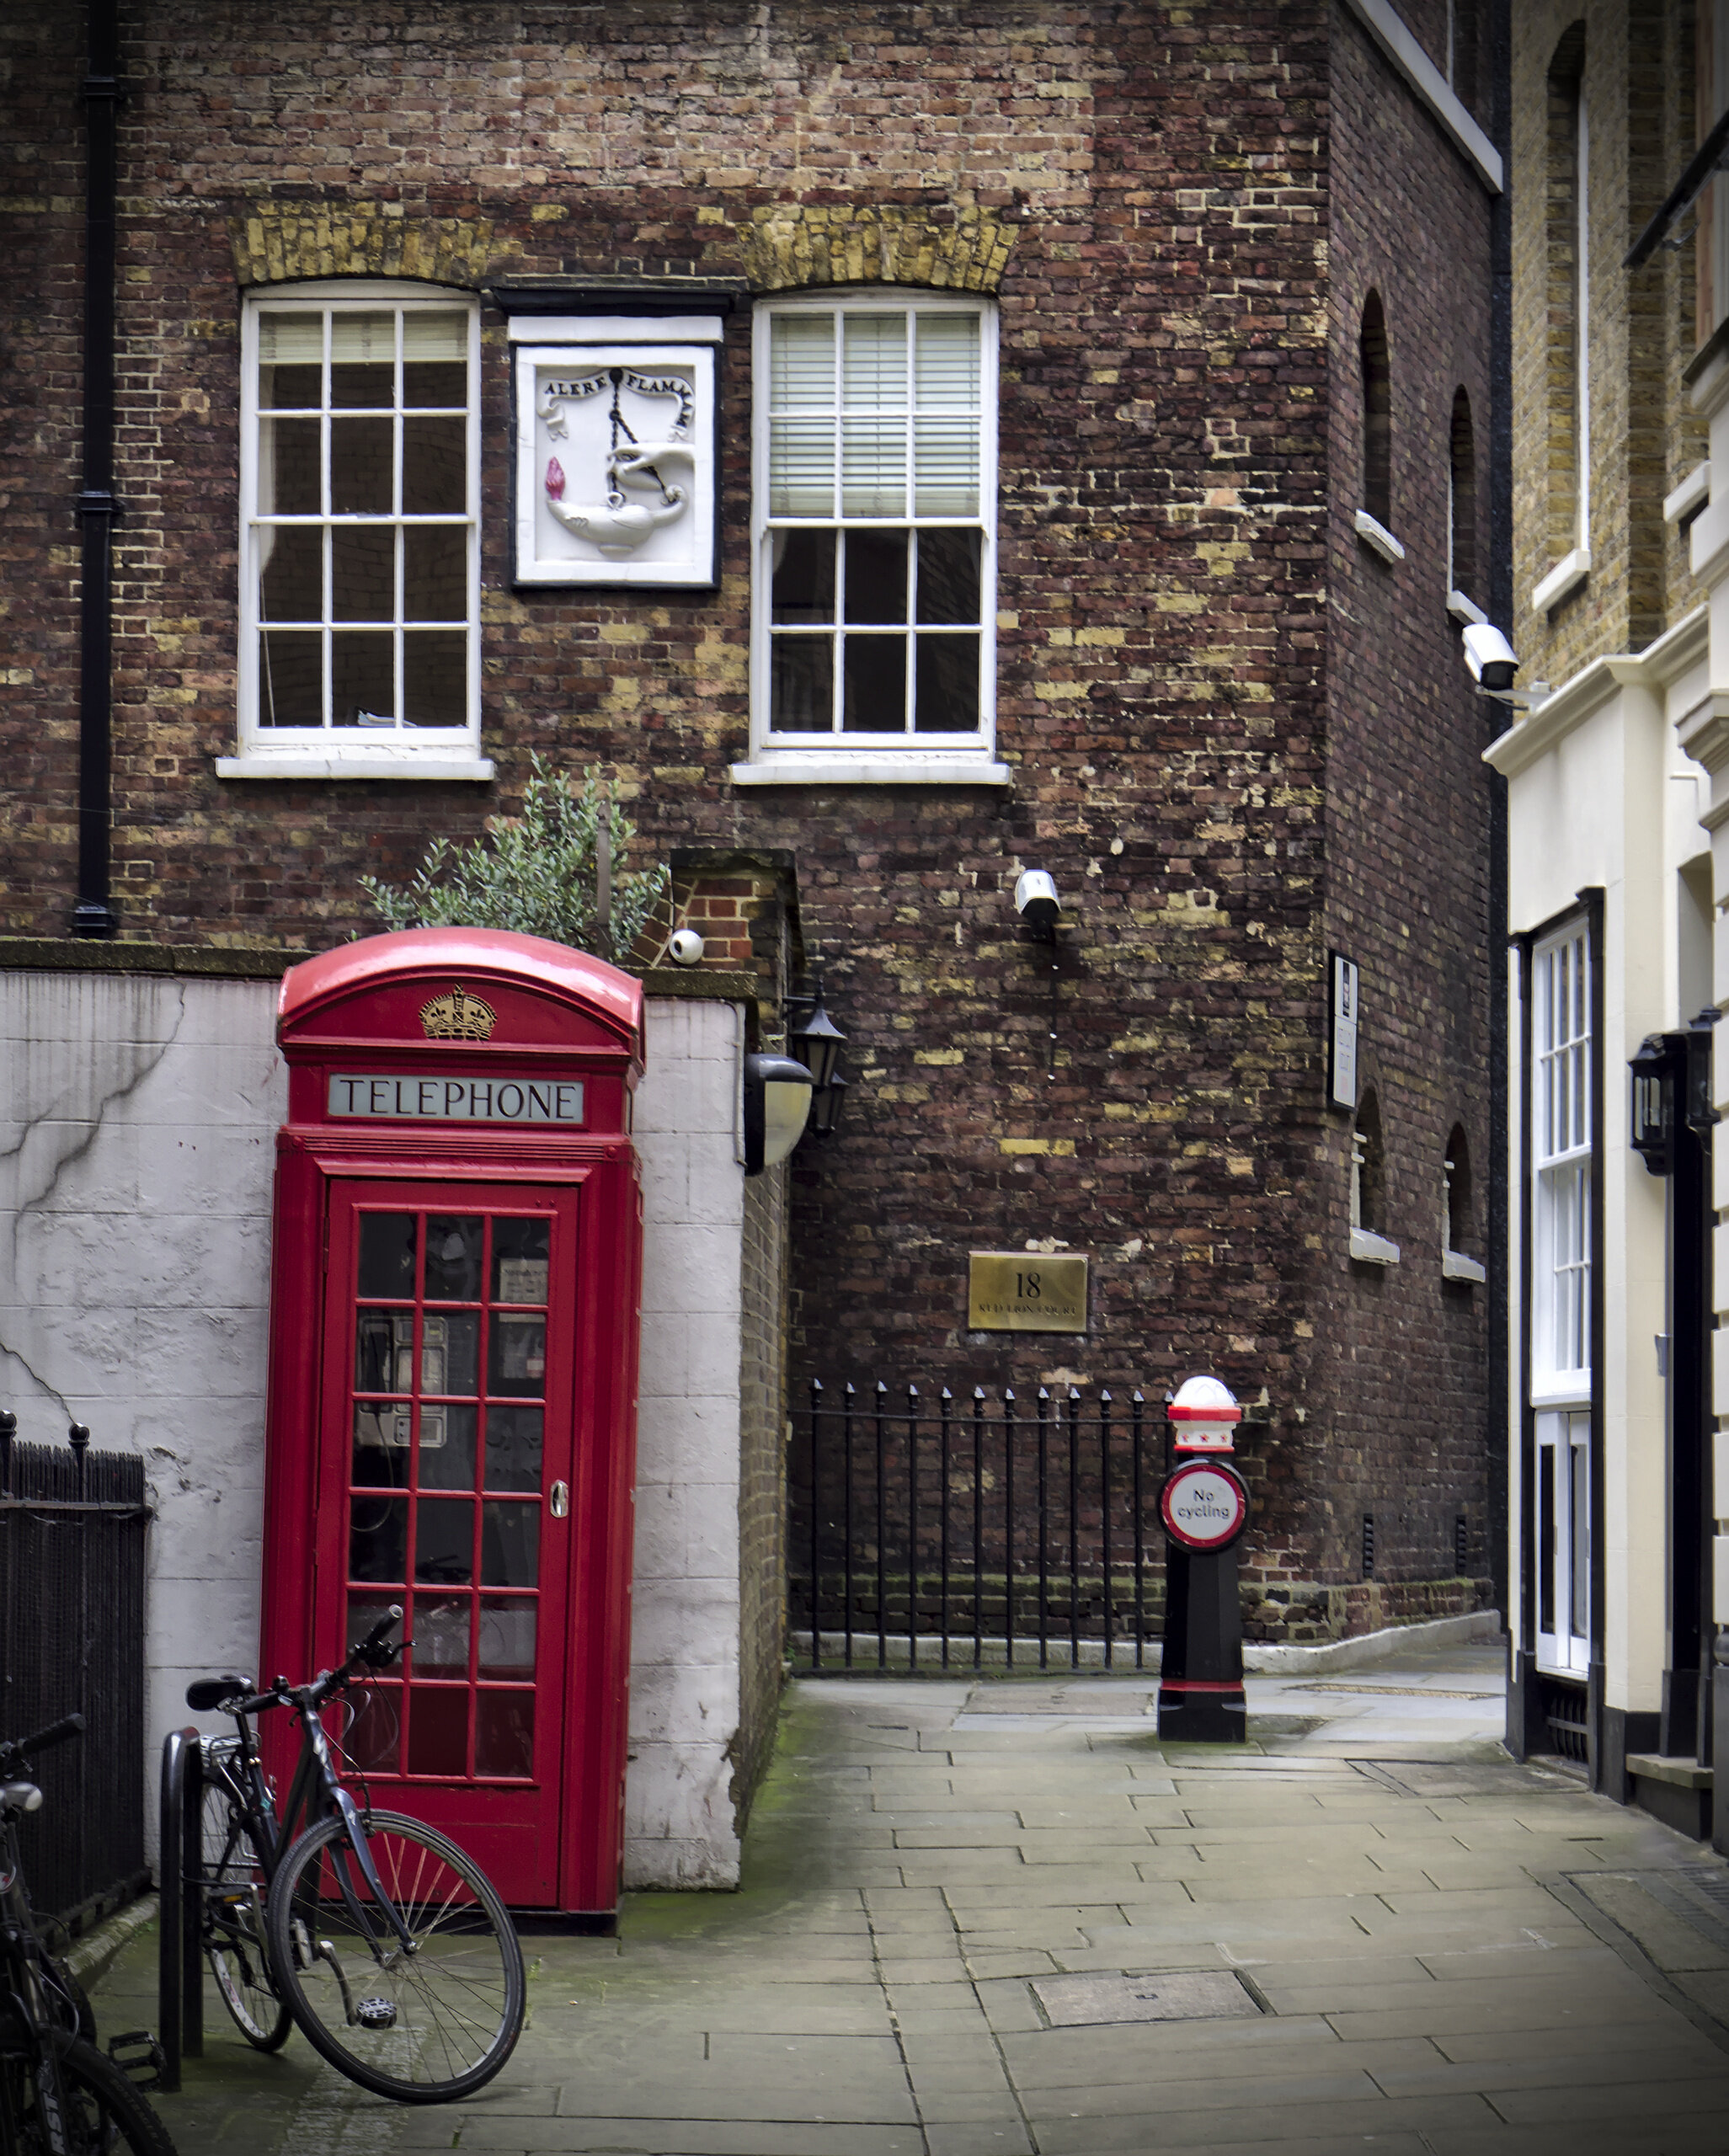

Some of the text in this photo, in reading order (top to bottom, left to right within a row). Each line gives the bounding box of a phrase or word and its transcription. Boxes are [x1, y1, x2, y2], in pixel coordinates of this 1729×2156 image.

[545, 375, 693, 428] ALERE FLAMMAM
[339, 1080, 576, 1119] TELEPHONE
[1017, 1272, 1041, 1299] 18
[1177, 1504, 1230, 1519] cycling
[1193, 1488, 1214, 1502] No
[42, 2091, 66, 2156] RST
